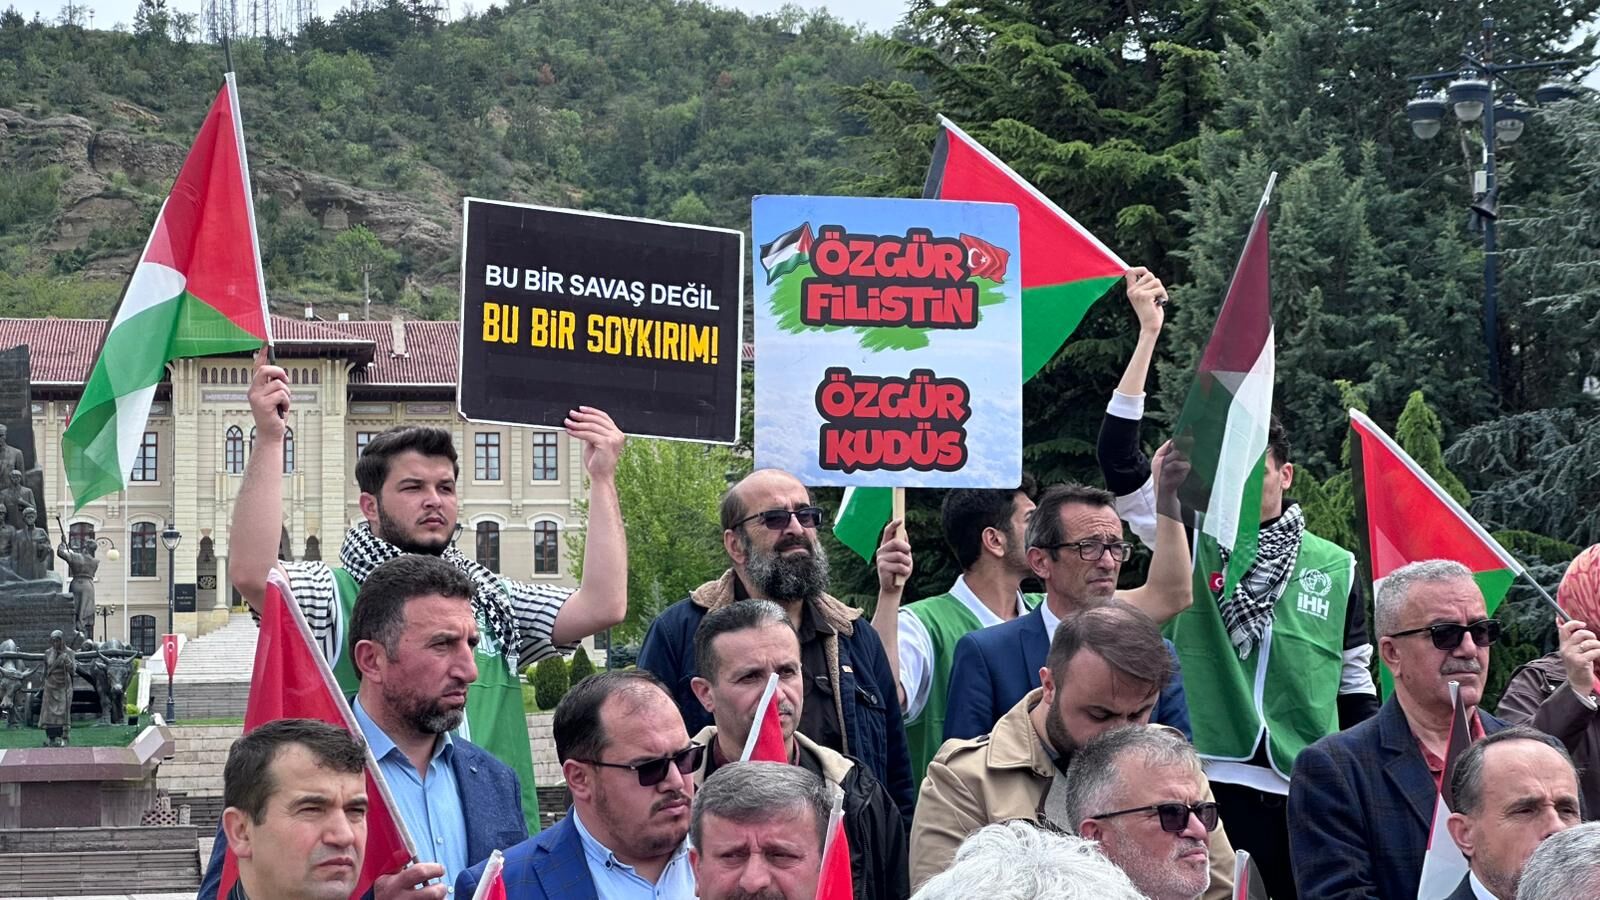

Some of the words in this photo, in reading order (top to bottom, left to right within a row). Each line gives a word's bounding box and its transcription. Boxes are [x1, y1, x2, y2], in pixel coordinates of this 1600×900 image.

[815, 231, 964, 282] ÖZGÜR
[485, 264, 519, 289] BU
[524, 266, 565, 295] BİR
[569, 274, 646, 307] SAVAŞ
[650, 281, 720, 311] DEĞİL
[482, 302, 519, 344] BU
[586, 313, 719, 364] SOYKIRIM!
[821, 373, 966, 421] ÖZGÜR
[825, 421, 962, 467] KUDÜS
